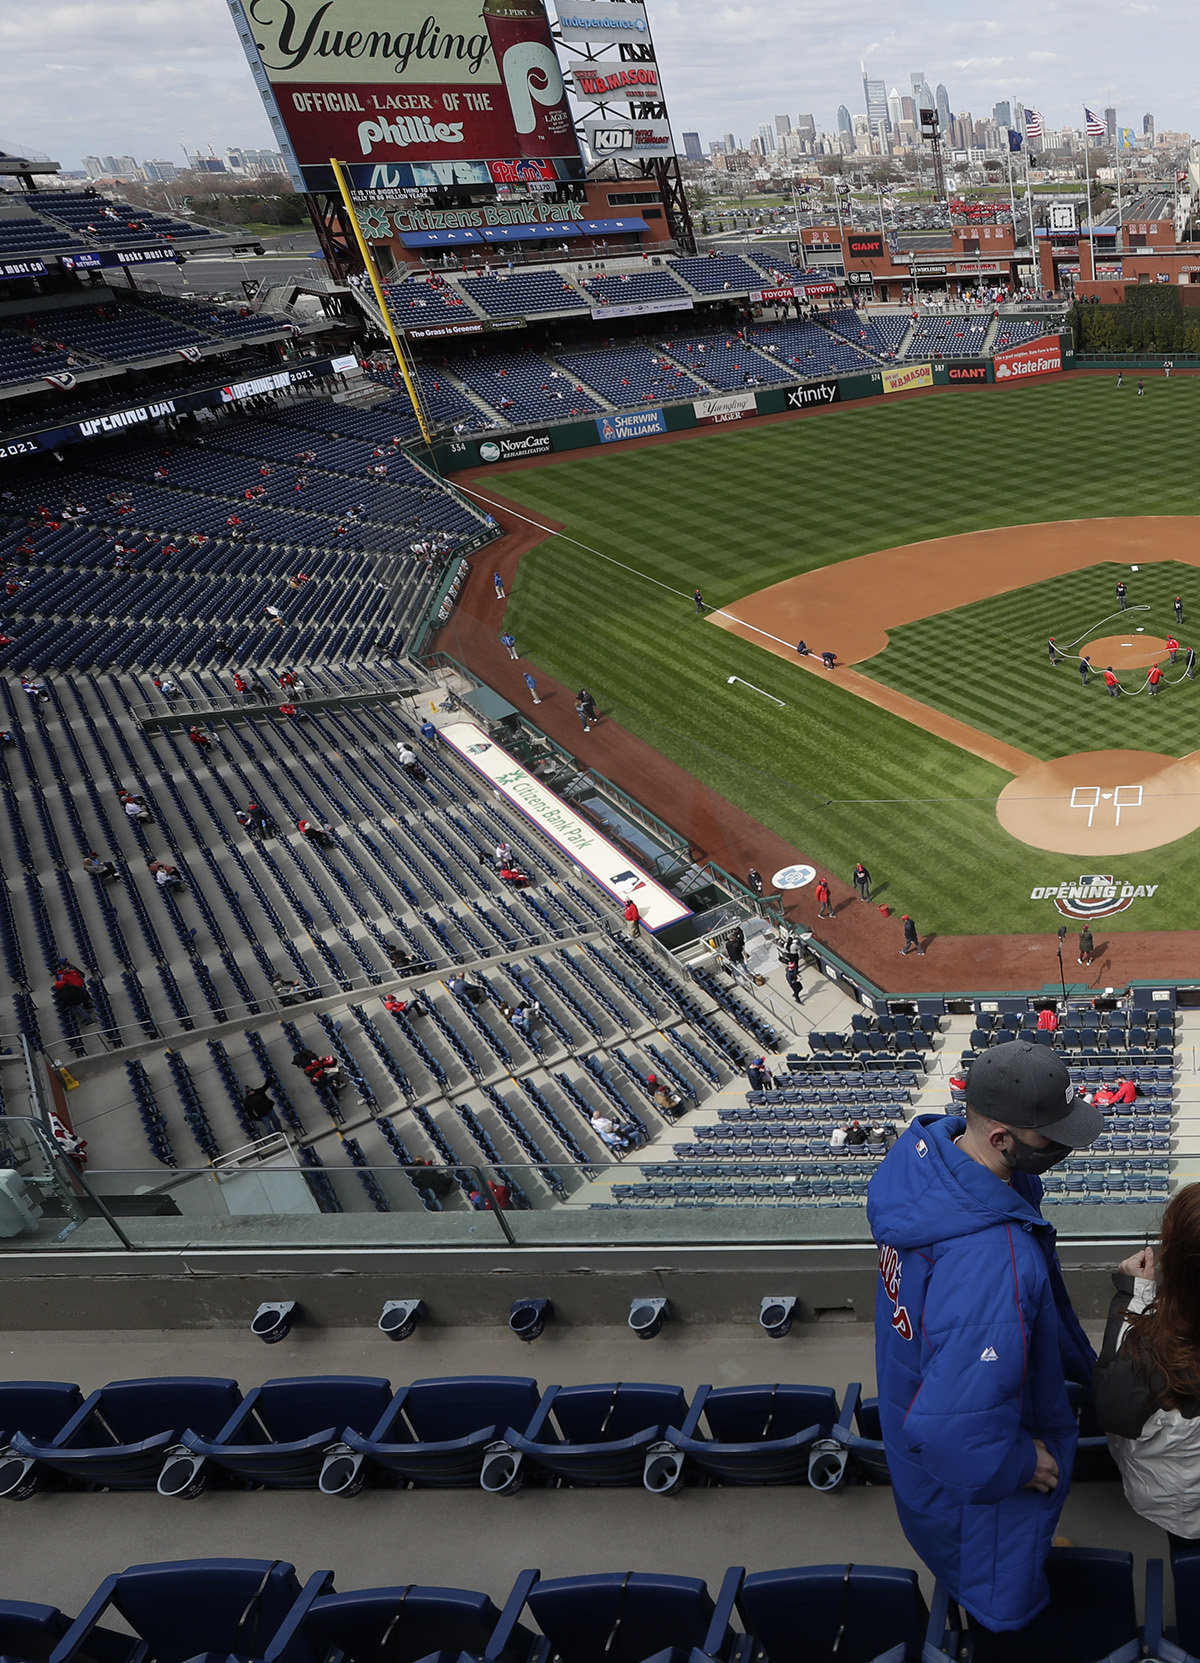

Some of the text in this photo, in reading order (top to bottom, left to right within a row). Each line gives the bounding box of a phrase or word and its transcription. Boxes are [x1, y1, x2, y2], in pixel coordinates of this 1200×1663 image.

[560, 16, 633, 30] Independence
[250, 0, 493, 74] Yuengling
[292, 92, 493, 112] OFFICIAL LAGER OF THE
[544, 112, 568, 122] LAGER
[432, 161, 472, 185] VS
[394, 200, 584, 231] Citizens Bank Park
[428, 229, 508, 240] HARRY
[852, 243, 879, 251] GIANT
[117, 252, 144, 262] Masks
[145, 251, 167, 260] must
[7, 263, 30, 275] must
[76, 260, 101, 268] NETWORK
[763, 290, 792, 299] TOYOTA
[806, 285, 834, 294] TOYOTA
[410, 330, 424, 338] The
[426, 328, 445, 336] Grass
[453, 325, 483, 333] Greener.
[890, 368, 930, 389] W.B.MASON
[949, 368, 985, 378] GIANT
[233, 370, 313, 400] OPENING DAY 2021
[788, 383, 836, 407] xfinity
[702, 398, 748, 416] Yuengling
[615, 412, 658, 427] SHERWIN
[714, 411, 742, 423] LAGER
[616, 423, 663, 438] WILLIAMS.
[0, 441, 37, 458] 2021
[452, 442, 466, 453] 334
[500, 435, 550, 452] NovaCare
[503, 446, 550, 459] REHABILITATION
[512, 782, 594, 850] Citizens Bank Park
[1030, 884, 1159, 900] OPENING DAY
